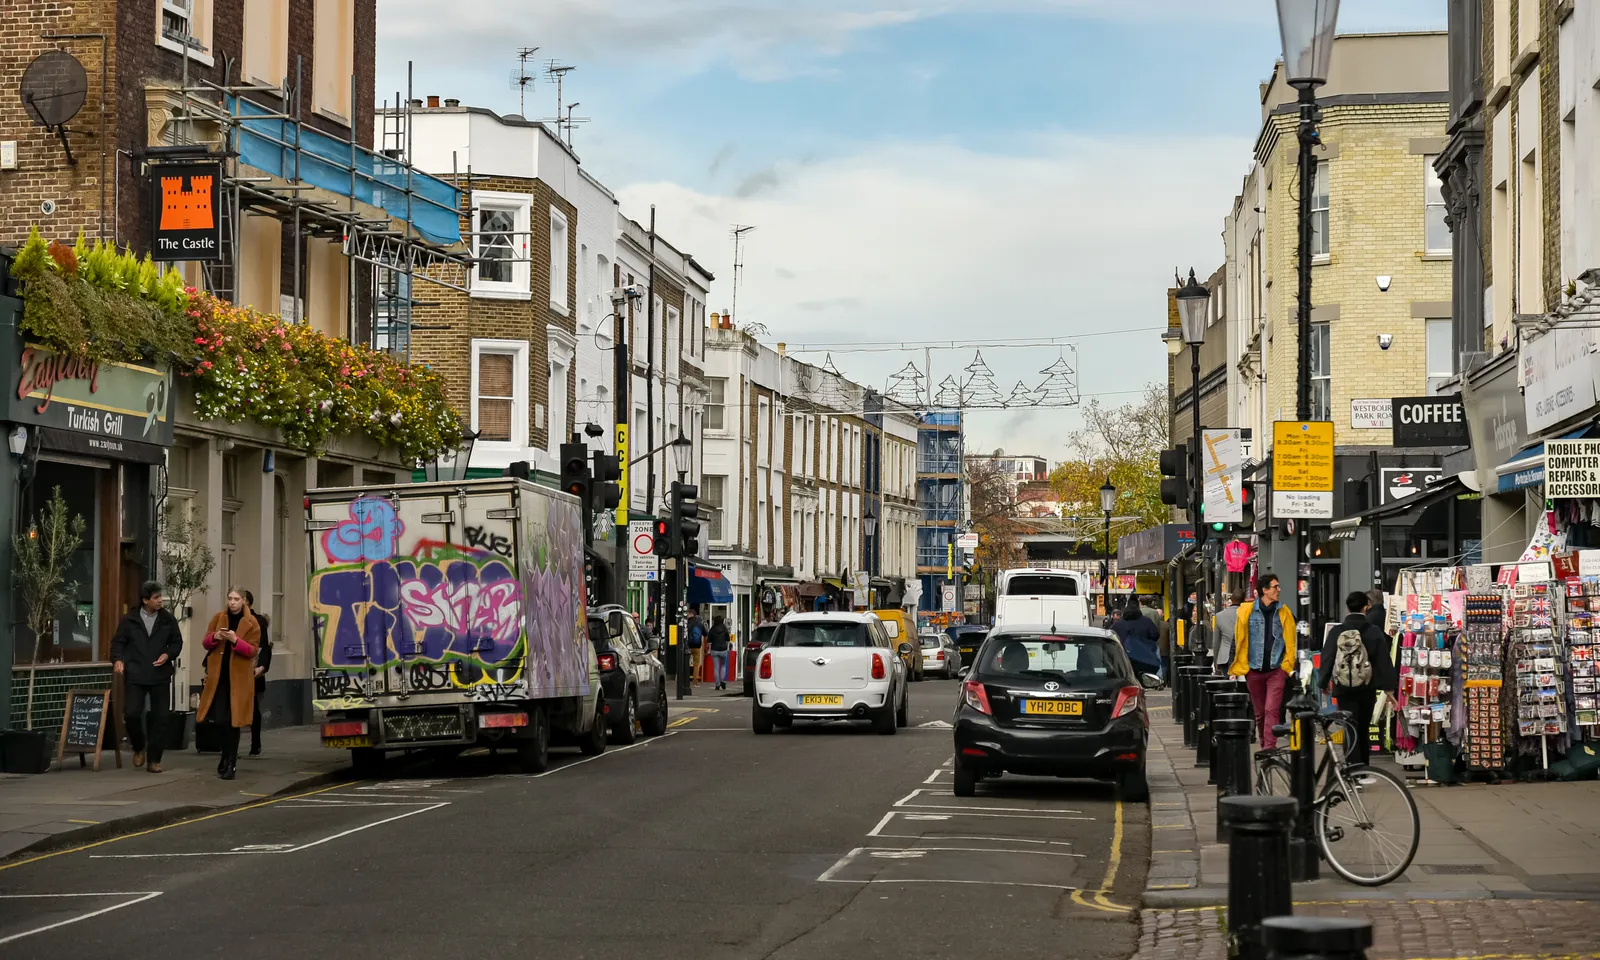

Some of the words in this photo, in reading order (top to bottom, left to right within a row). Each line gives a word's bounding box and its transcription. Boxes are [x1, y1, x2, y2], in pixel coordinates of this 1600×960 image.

[158, 238, 179, 249] The
[182, 237, 215, 249] Castle
[1400, 403, 1462, 424] COFFEE
[68, 406, 100, 432] Turkish
[104, 412, 123, 436] Grill
[1548, 444, 1582, 454] MOBILE
[1548, 457, 1599, 468] COMPUTER
[1549, 470, 1587, 482] REPAIRS
[1589, 472, 1597, 482] &
[805, 696, 822, 704] EK13
[823, 696, 839, 704] YNC
[1030, 701, 1053, 712] YH12
[1057, 702, 1078, 713] OBC
